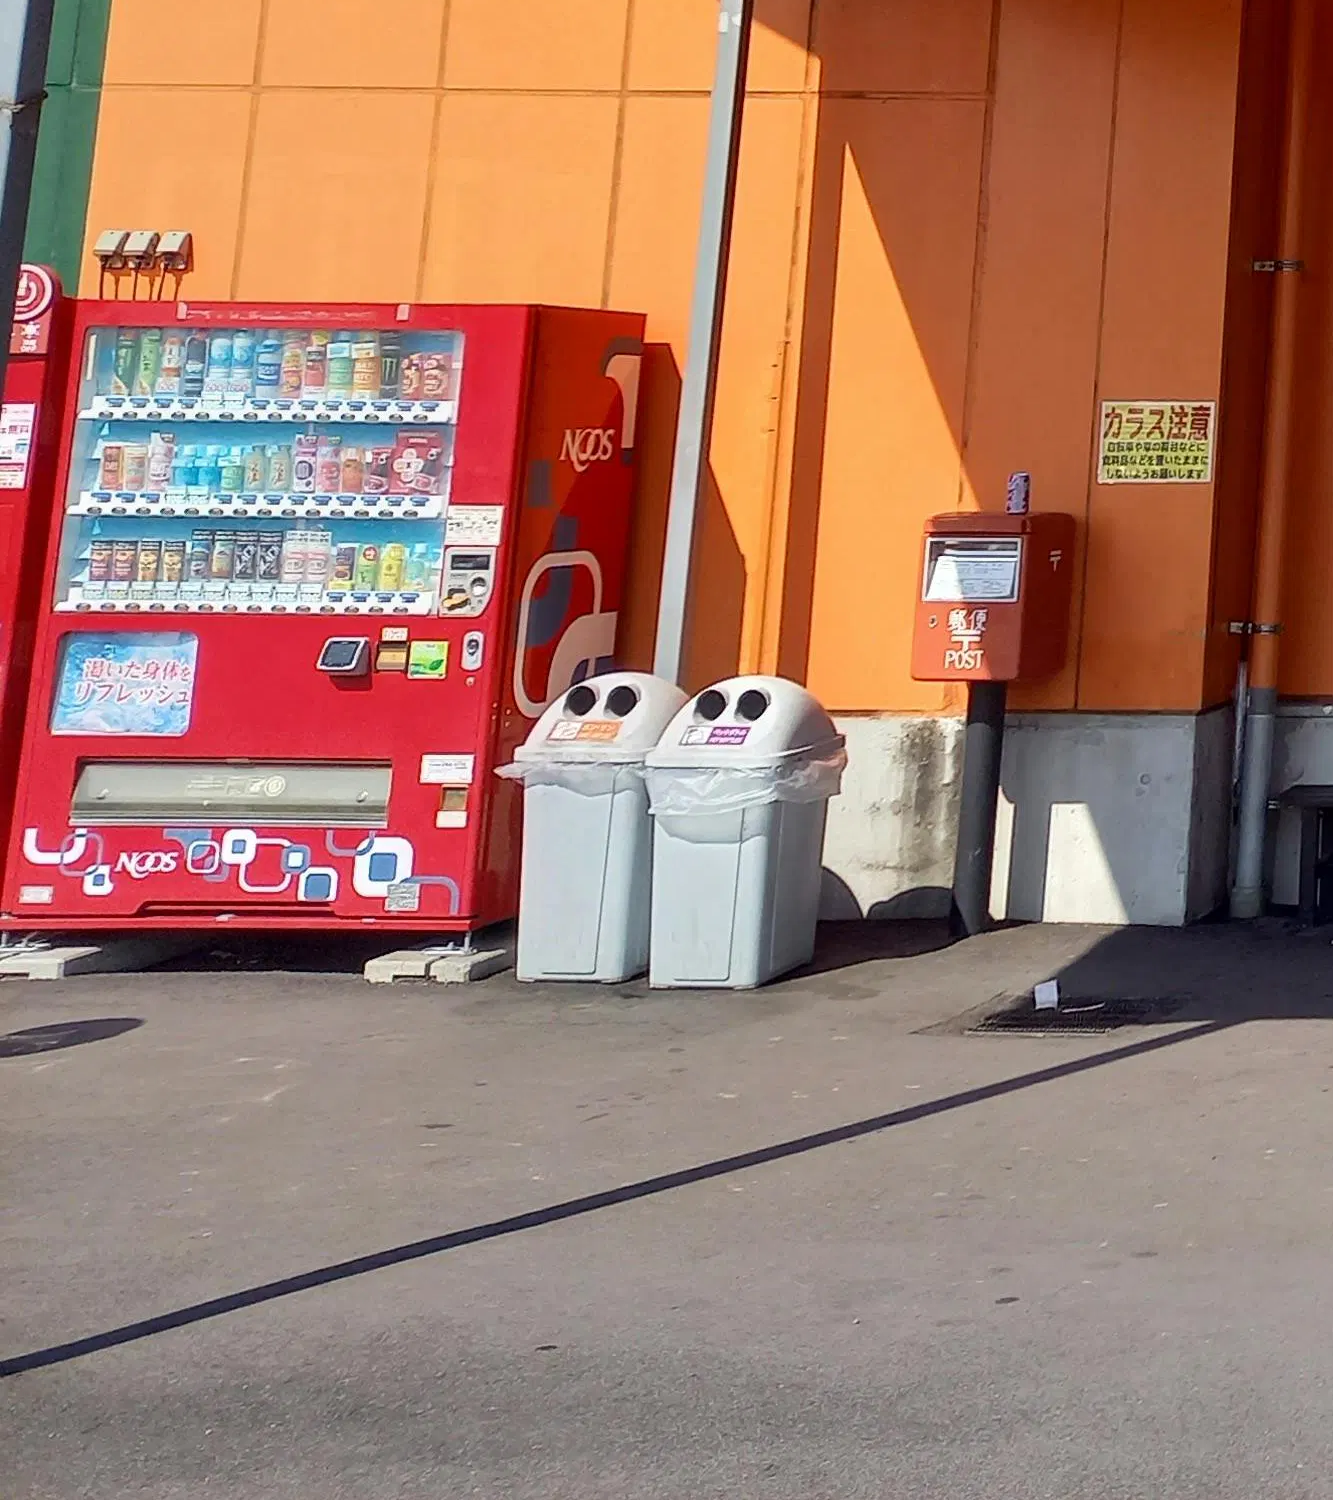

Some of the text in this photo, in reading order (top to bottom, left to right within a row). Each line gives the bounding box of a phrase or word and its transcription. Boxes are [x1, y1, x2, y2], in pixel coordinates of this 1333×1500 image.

[1103, 405, 1211, 440] カラス注意
[948, 609, 988, 631] 郵便
[85, 659, 192, 682] 渇いた身体を
[944, 649, 984, 670] POST
[74, 683, 190, 704] リフレッシュ
